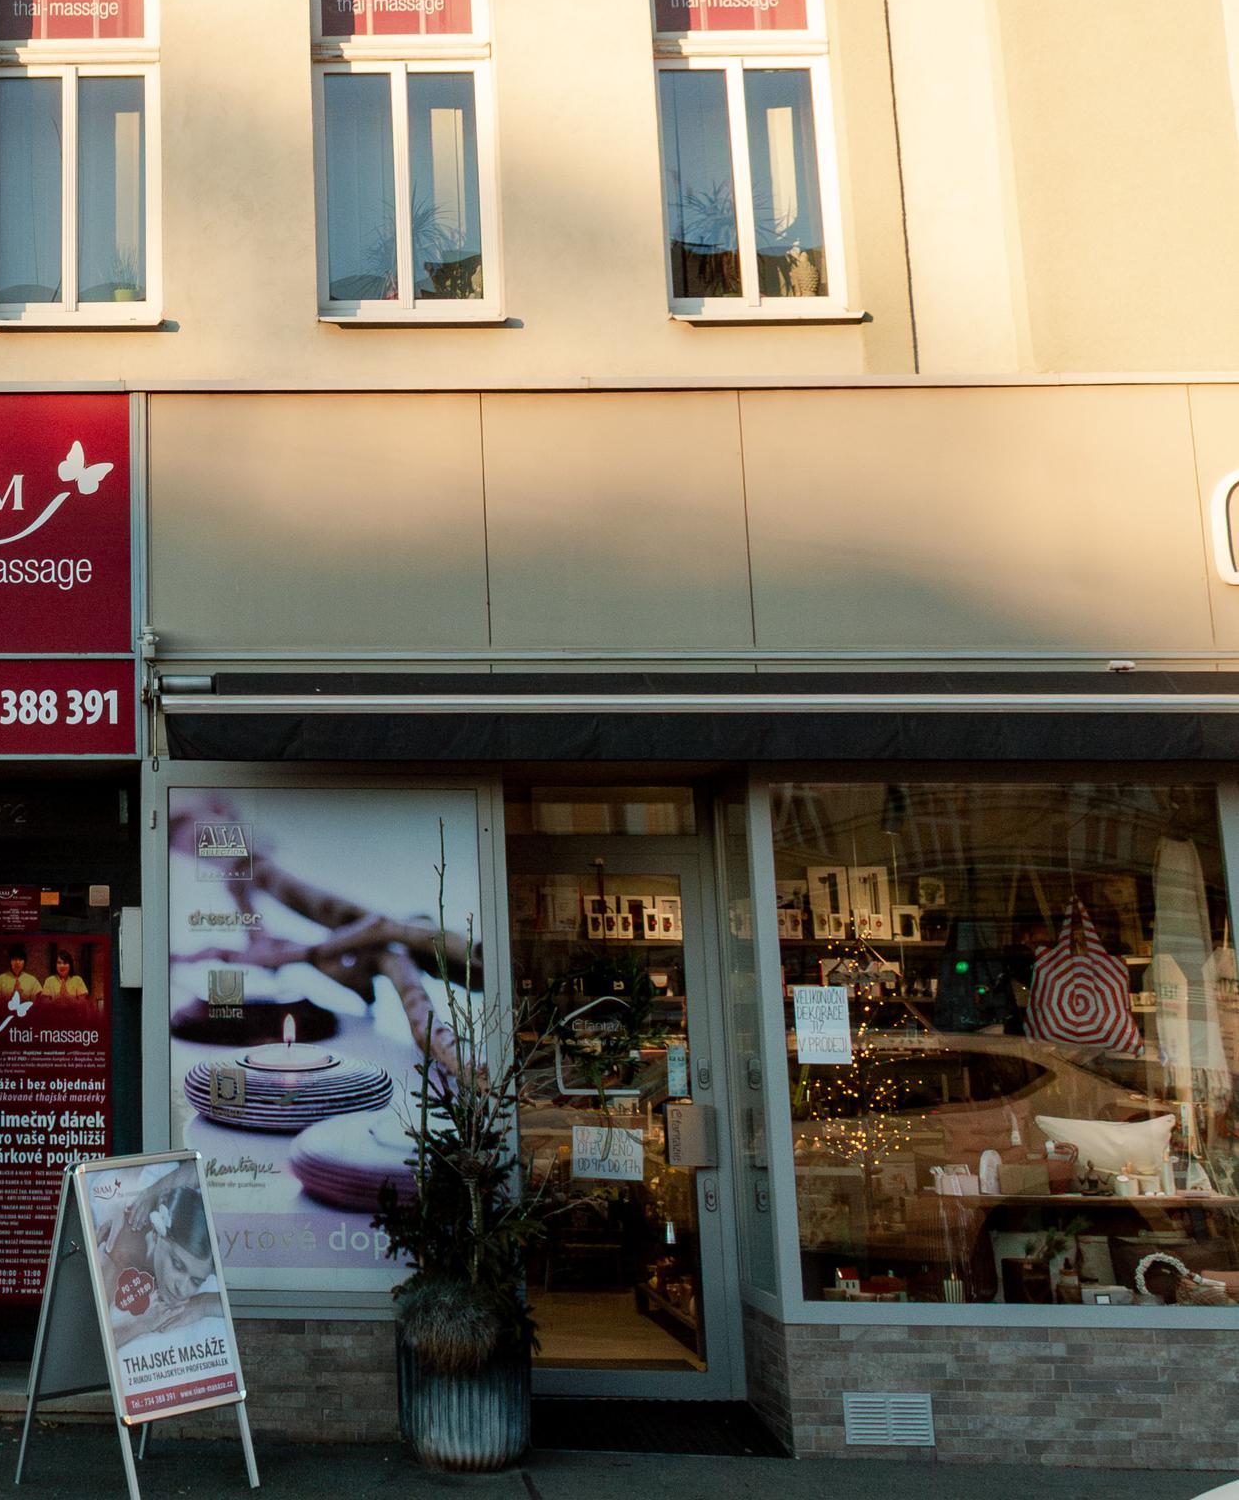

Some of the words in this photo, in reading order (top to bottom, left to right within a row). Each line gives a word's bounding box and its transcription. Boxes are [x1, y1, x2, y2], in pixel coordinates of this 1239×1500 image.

[13, 0, 119, 20] thai-massage
[0, 689, 59, 725] 388
[65, 689, 119, 725] 391
[208, 1005, 244, 1019] umbra
[796, 1005, 845, 1021] DEKORACE
[9, 1026, 99, 1047] thai-massage
[19, 1078, 23, 1090] i
[27, 1078, 46, 1090] bez
[49, 1078, 105, 1093] objednání
[35, 1092, 67, 1104] thajské
[69, 1092, 106, 1104] masérky
[59, 1110, 105, 1128] dárek
[16, 1130, 45, 1145] vaše
[49, 1130, 105, 1149] nejbližší
[577, 1140, 634, 1157] OTEVENO
[217, 1223, 317, 1258] ytové
[123, 1345, 176, 1374] THAJSKÉ
[178, 1336, 226, 1362] MASÁŽE
